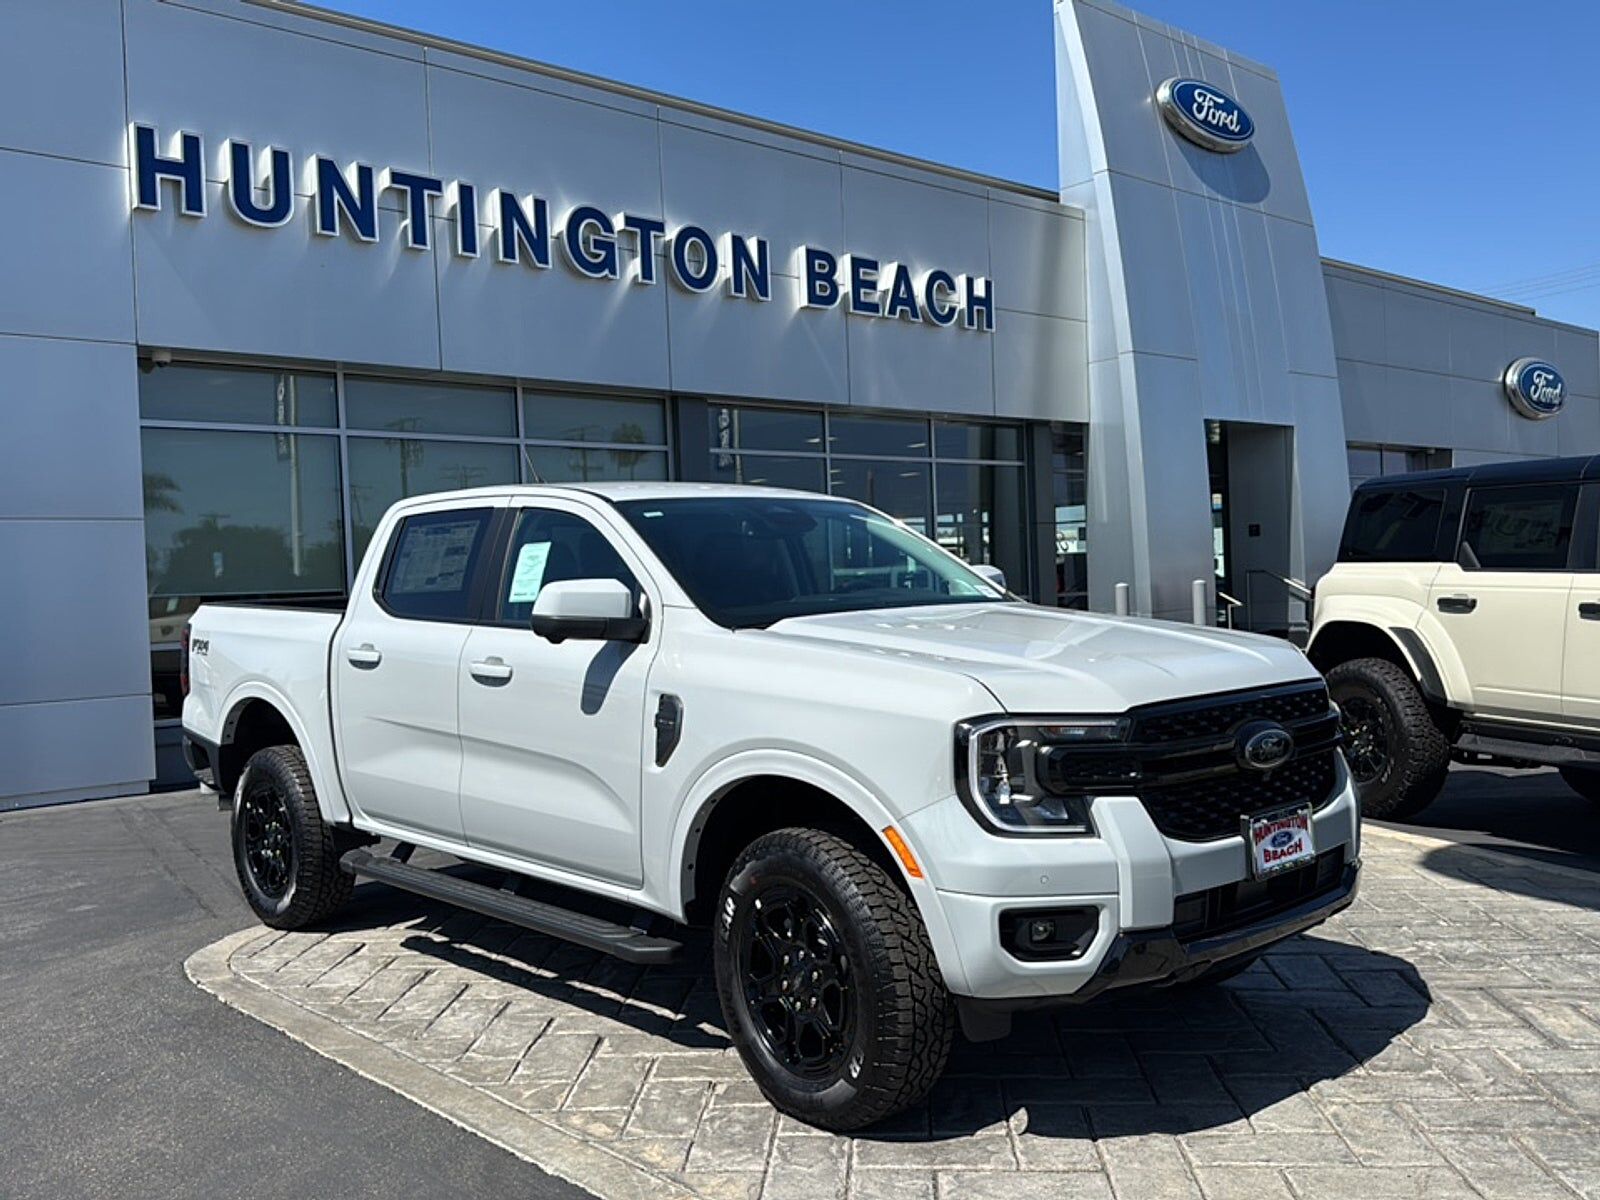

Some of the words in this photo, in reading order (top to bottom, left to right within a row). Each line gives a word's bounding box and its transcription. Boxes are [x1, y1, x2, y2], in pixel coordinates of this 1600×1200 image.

[1192, 88, 1241, 133] Ford
[130, 122, 771, 301] HUNTINGTON
[799, 245, 995, 332] BEACH
[1530, 369, 1562, 404] Ford
[1254, 813, 1308, 846] HUNTINGTON
[1263, 837, 1303, 863] BEACH
